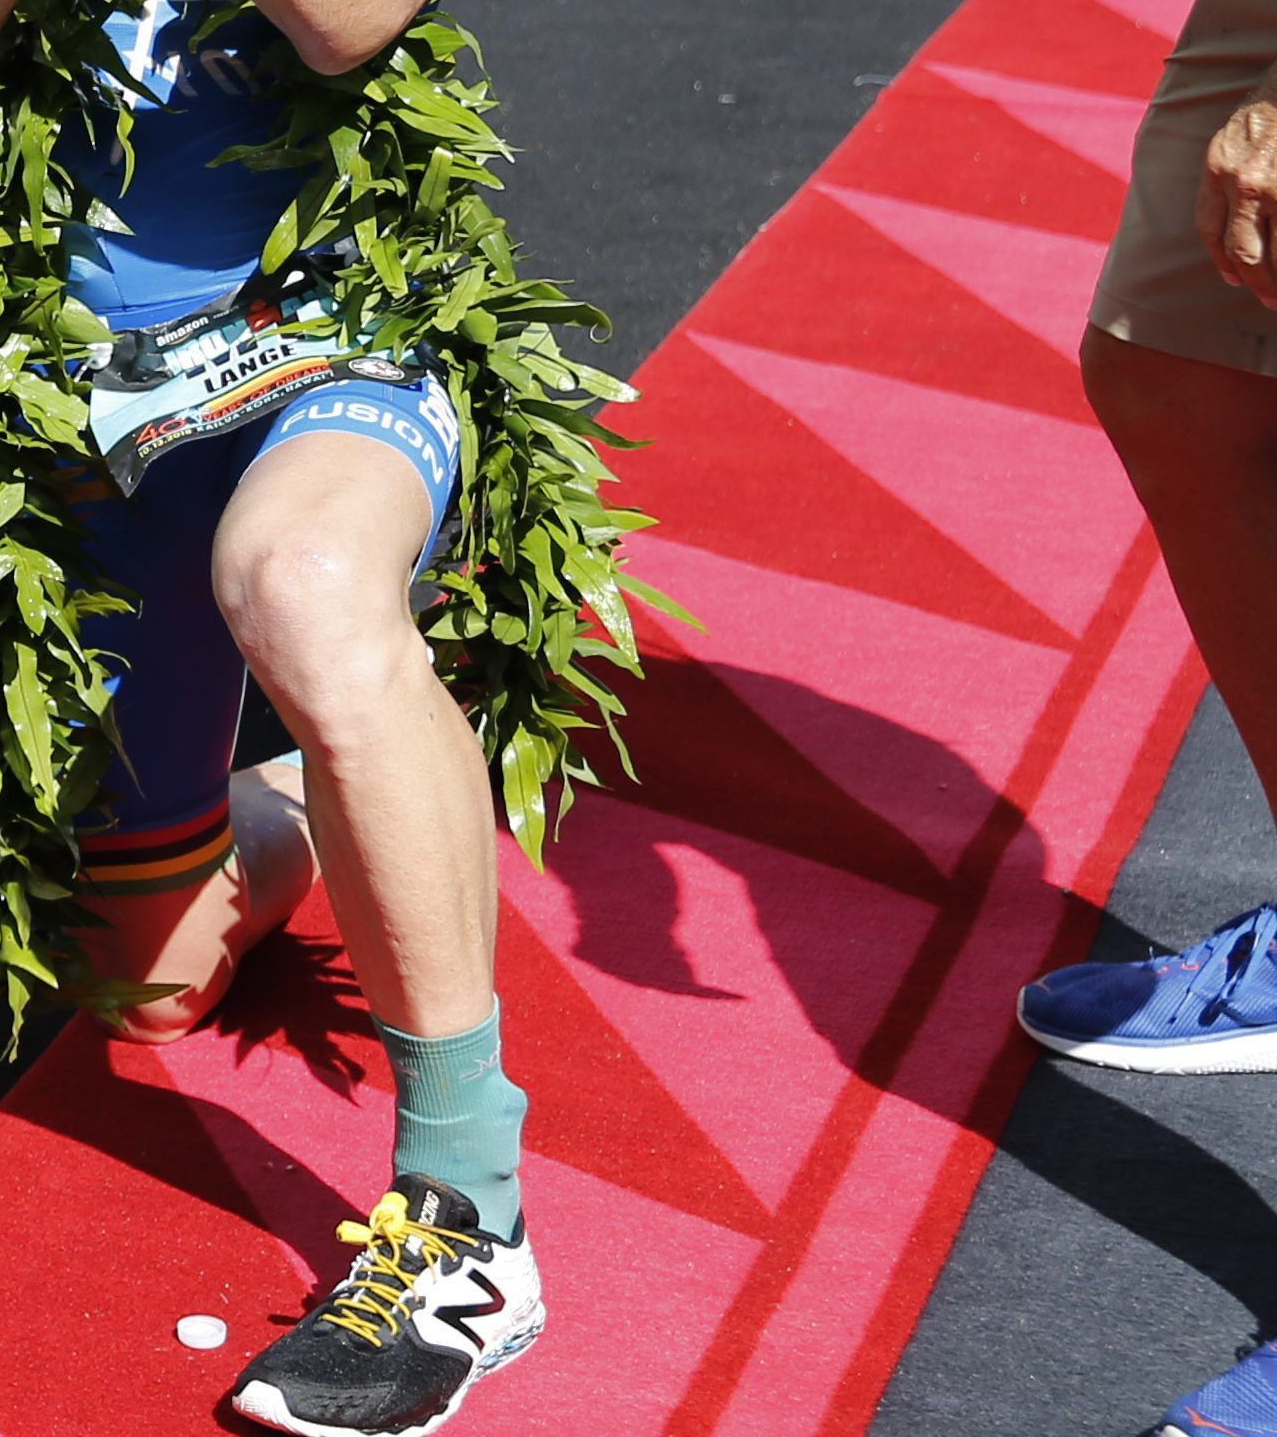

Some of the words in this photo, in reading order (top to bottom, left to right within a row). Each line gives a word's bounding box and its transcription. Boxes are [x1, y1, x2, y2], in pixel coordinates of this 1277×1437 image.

[155, 315, 209, 348] amazon
[204, 343, 297, 393] LANGE
[203, 399, 247, 422] YEARS
[250, 385, 271, 401] OF
[276, 364, 334, 388] DREAMS
[134, 419, 186, 445] 40
[137, 427, 193, 459] 10.13.2018
[280, 401, 445, 485] FUSION
